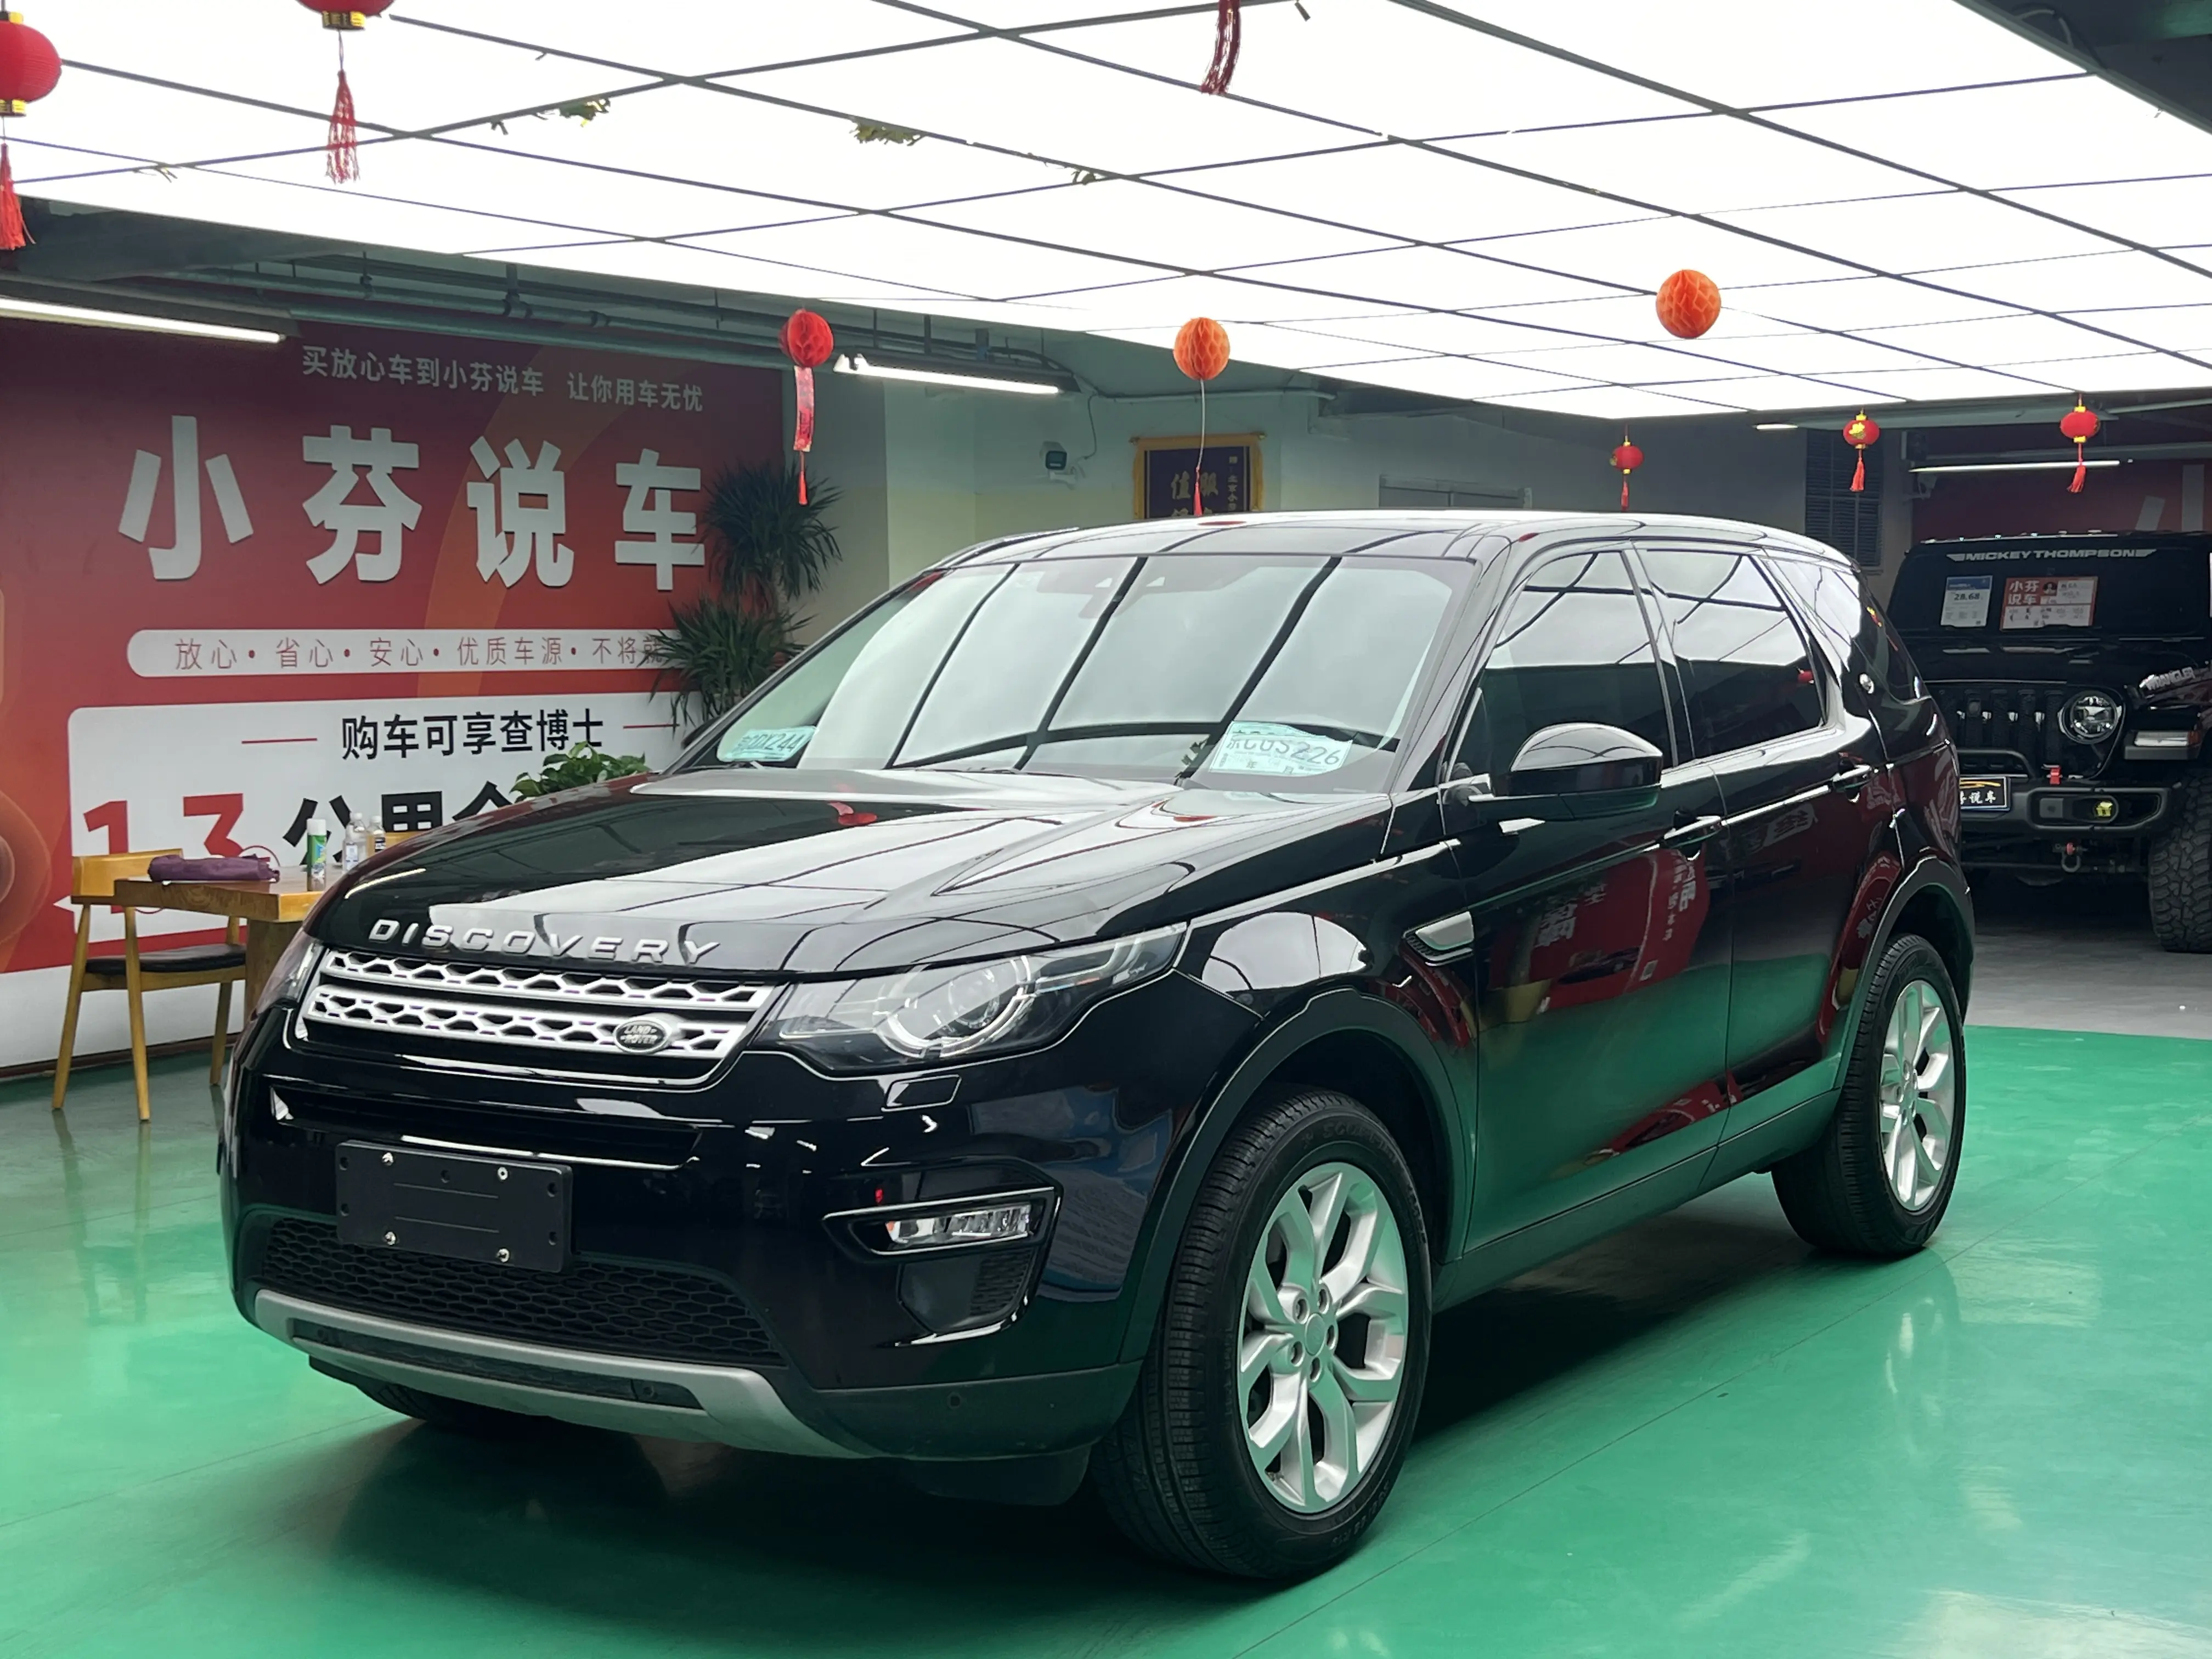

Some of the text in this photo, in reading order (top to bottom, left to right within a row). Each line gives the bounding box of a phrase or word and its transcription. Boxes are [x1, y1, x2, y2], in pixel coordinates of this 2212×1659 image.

[302, 345, 703, 412] 买放心车到小芬说车 让你用车无忧
[118, 415, 706, 591] 小芬说车
[1964, 551, 2032, 561] MICKEY
[342, 708, 603, 760] 购车可享查博士
[368, 918, 721, 966] DISCOVERY
